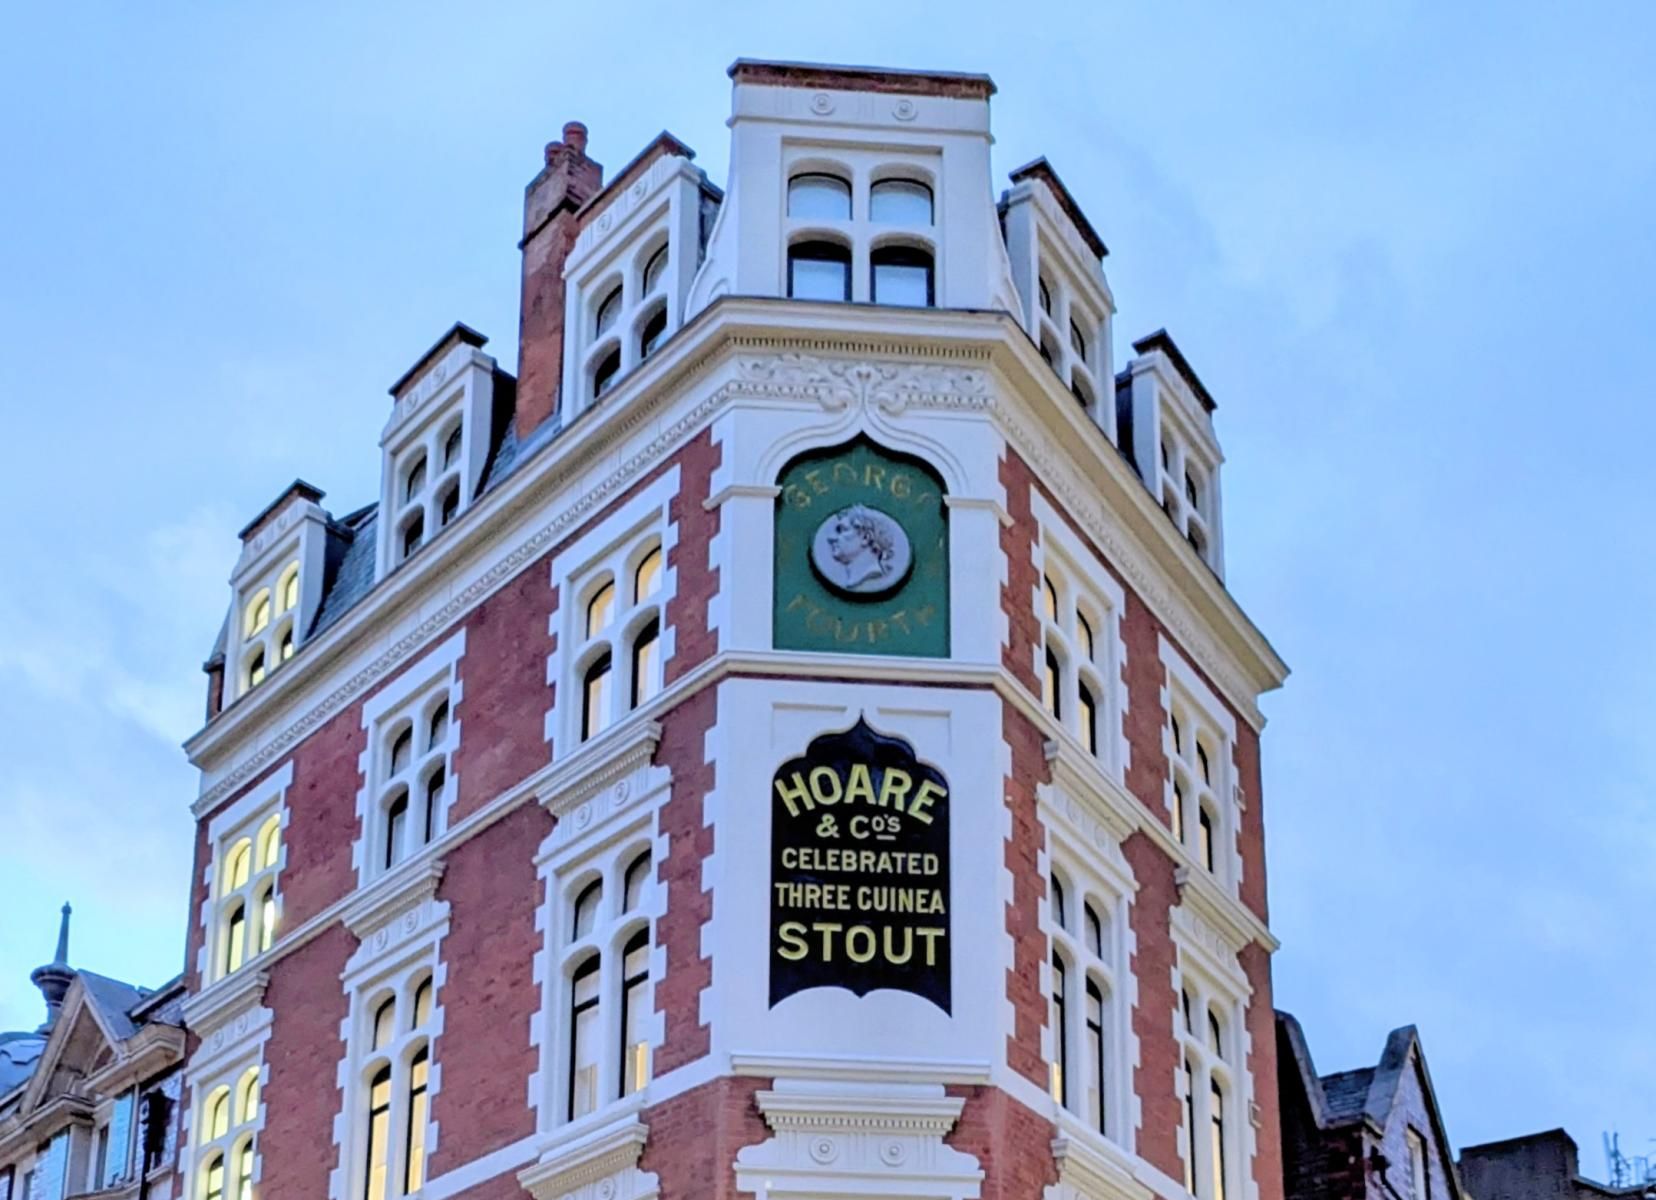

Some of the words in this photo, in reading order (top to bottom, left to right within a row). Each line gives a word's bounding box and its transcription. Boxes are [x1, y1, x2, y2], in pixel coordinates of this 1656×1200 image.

[774, 763, 948, 825] HOARE
[815, 813, 840, 838] &
[781, 847, 939, 875] CELEBRATED
[774, 882, 851, 910] THREE
[777, 921, 946, 966] STOUT
